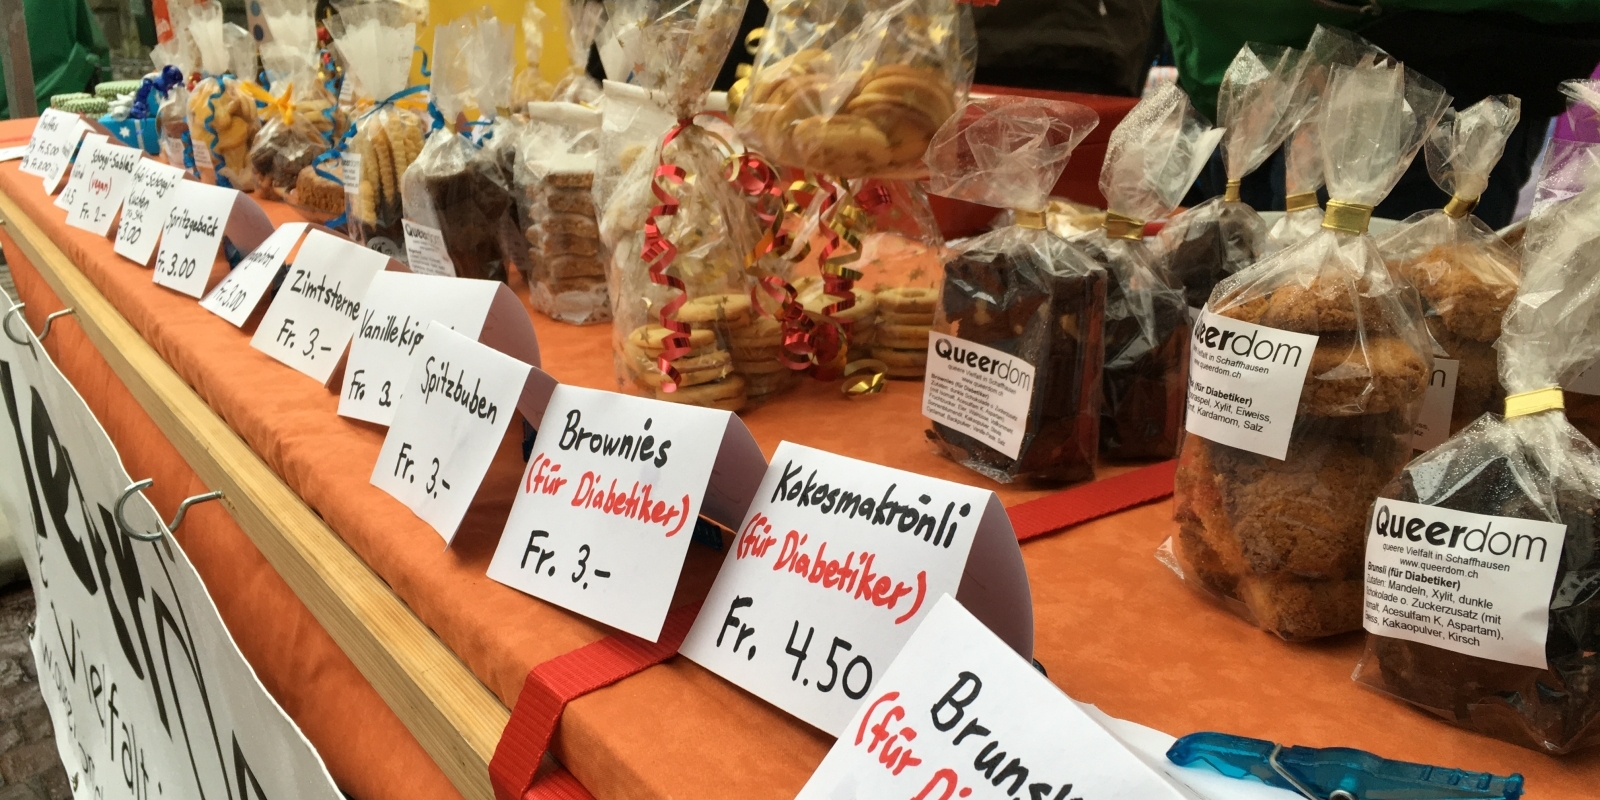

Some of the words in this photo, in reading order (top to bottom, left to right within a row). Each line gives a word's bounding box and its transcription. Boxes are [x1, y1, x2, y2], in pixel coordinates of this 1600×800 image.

[88, 171, 112, 199] (vegan)
[80, 202, 89, 219] Fr.
[166, 206, 218, 239] Spritzgebäck
[157, 250, 165, 273] Fr.
[167, 253, 195, 278] 3.00
[290, 269, 360, 321] Zimtsterne
[275, 318, 295, 348] Fr.
[302, 328, 332, 360] 3.-
[358, 309, 424, 355] Vanillekip
[1194, 322, 1302, 367] eerdom
[935, 338, 1031, 391] Queerdom
[1194, 358, 1242, 379] ww.queerdom.ch
[1215, 355, 1270, 375] Schaffhausen
[347, 370, 365, 400] Fr.
[420, 356, 497, 425] Spitzbuben
[1206, 385, 1253, 407] Diabetiker)
[1197, 406, 1241, 428] Kardamom,
[1243, 420, 1263, 433] Salz
[1213, 400, 1233, 415] Xylit,
[1235, 405, 1272, 425] Eiweiss,
[558, 409, 671, 468] Brownies
[393, 442, 414, 484] Fr.
[425, 457, 450, 499] 3.-
[525, 452, 568, 496] (für
[570, 470, 690, 538] Diabetiker)
[771, 459, 971, 548] Kokosmakrönli
[1375, 504, 1548, 562] Queerdom
[520, 529, 556, 577] Fr.
[571, 543, 611, 590] 3.-
[736, 512, 777, 561] (für
[773, 529, 927, 625] Diabetiker)
[1382, 542, 1405, 554] queere
[1406, 546, 1434, 560] Vielfalt
[1435, 552, 1443, 561] in
[1445, 553, 1510, 572] Schaffhausen
[1399, 558, 1479, 579] www.queerdom.ch
[1366, 573, 1387, 588] Zutaten:
[1388, 579, 1429, 598] Mandeln,
[1431, 588, 1456, 603] Xylit,
[1458, 594, 1493, 609] dunkle
[1368, 561, 1387, 575] Brunsli
[1387, 567, 1403, 579] (für
[1405, 570, 1461, 592] Diabetiker)
[1382, 603, 1431, 624] Acesulfam
[1433, 615, 1443, 628] K,
[1447, 620, 1504, 641] Aspartam),
[1400, 597, 1409, 605] o.
[1411, 597, 1478, 620] Zuckerzusatz
[1481, 611, 1502, 625] (mit
[716, 595, 756, 661] Fr.
[785, 619, 873, 700] 4.50
[1382, 617, 1445, 640] Kakaopulver,
[1448, 632, 1480, 647] Kirsch
[854, 691, 922, 776] (für
